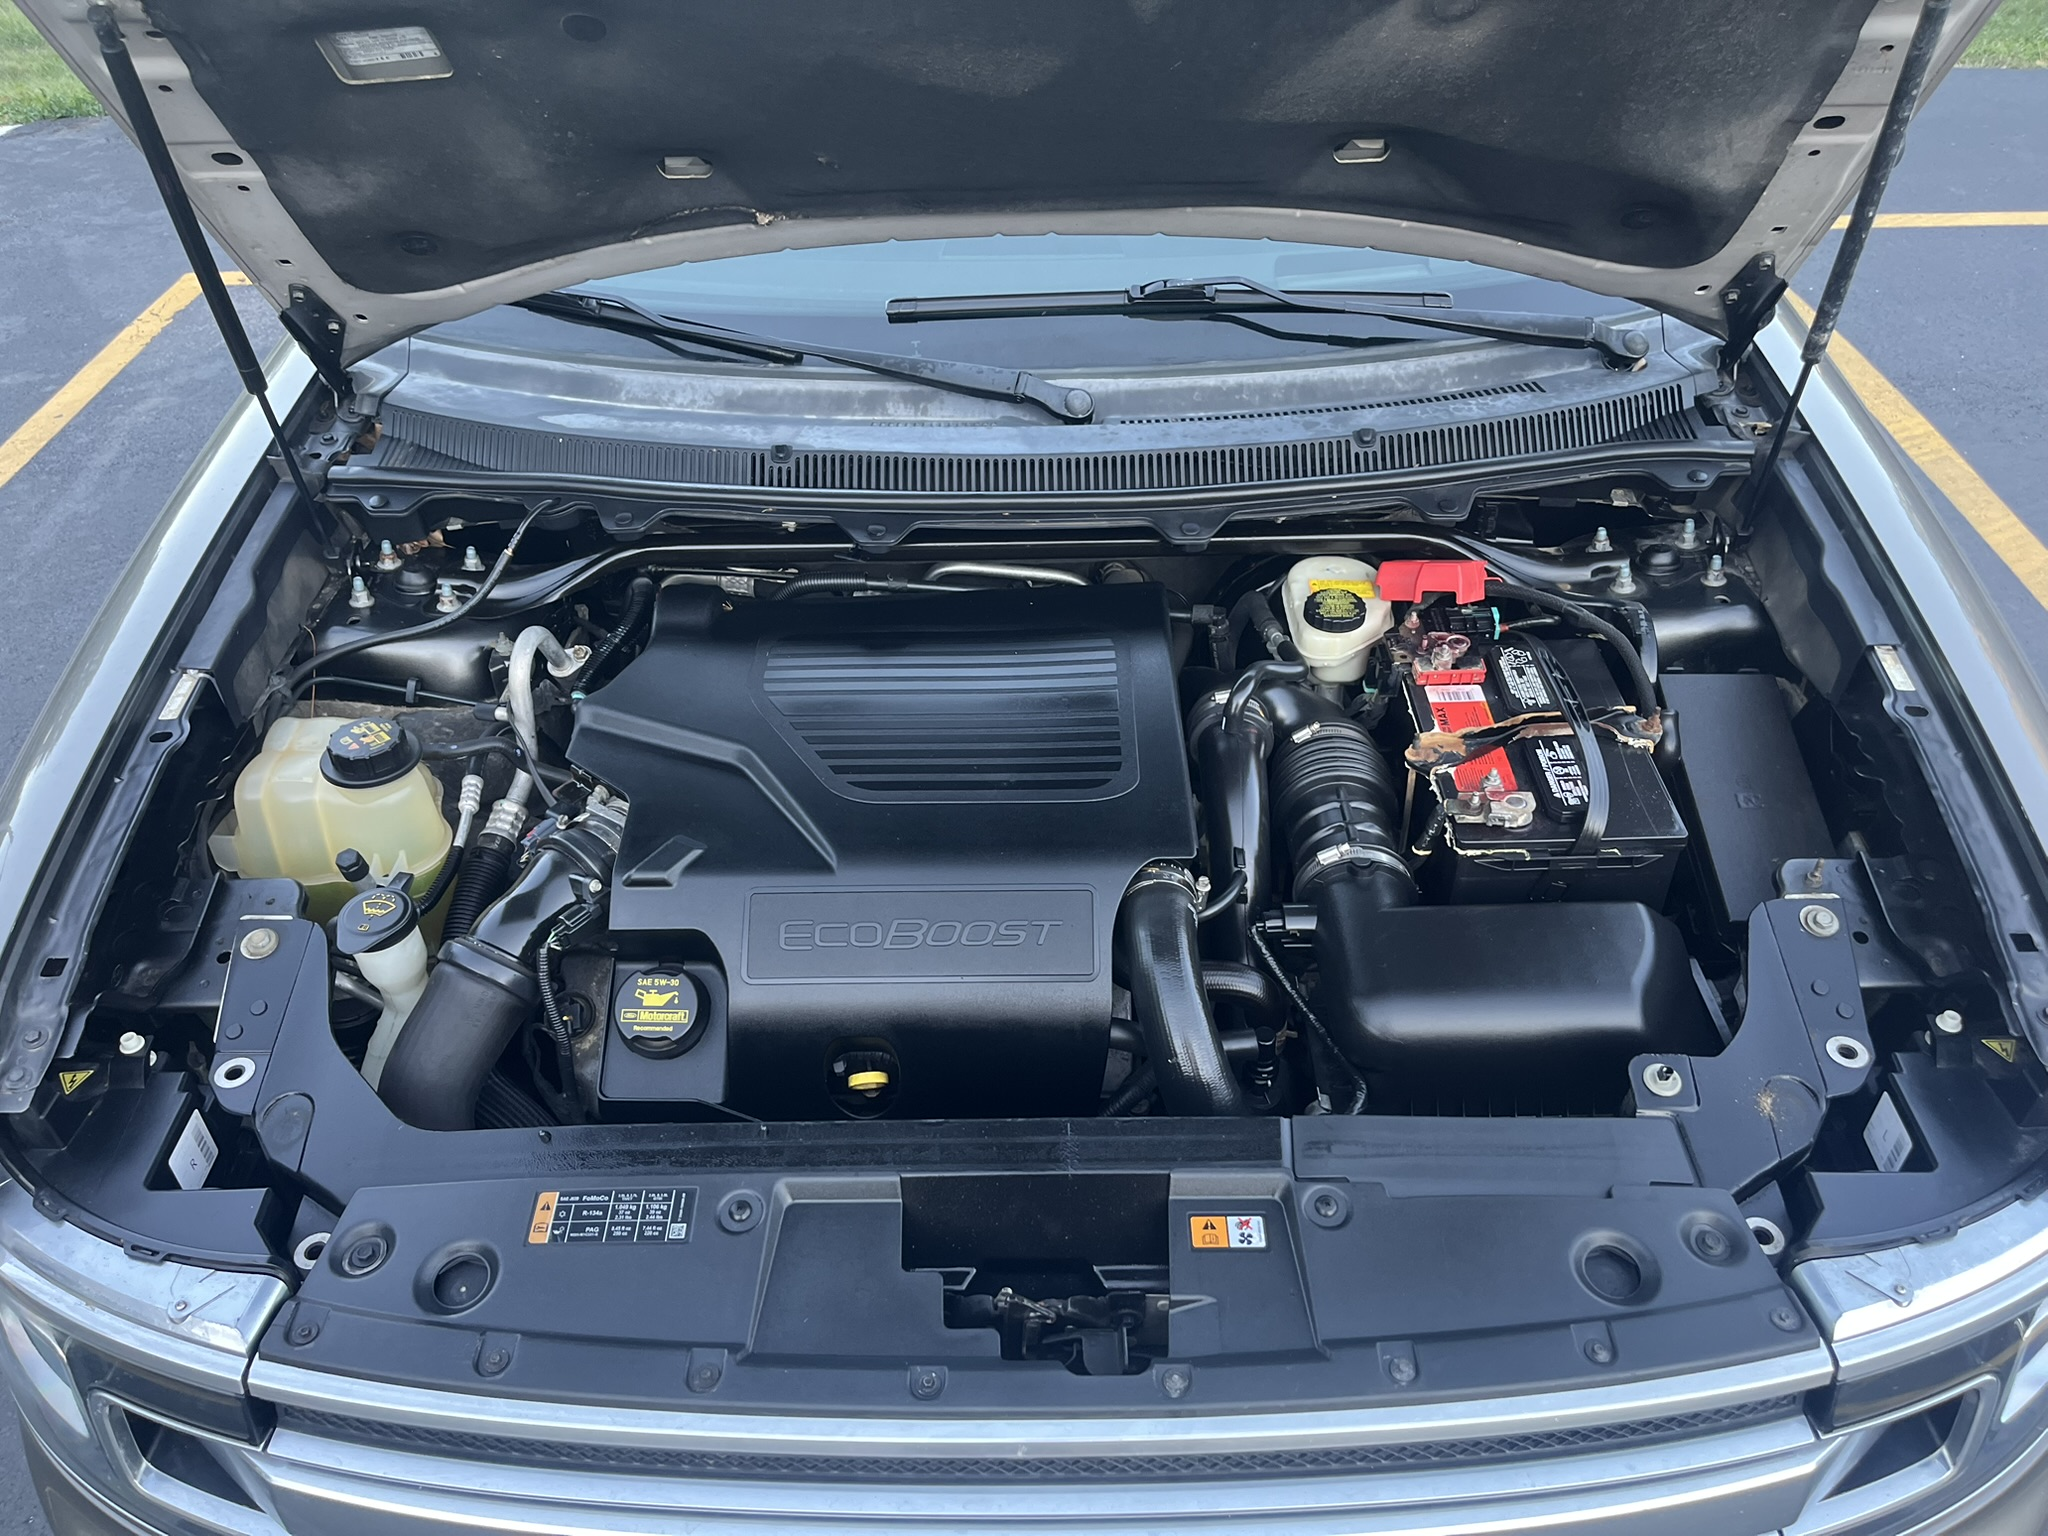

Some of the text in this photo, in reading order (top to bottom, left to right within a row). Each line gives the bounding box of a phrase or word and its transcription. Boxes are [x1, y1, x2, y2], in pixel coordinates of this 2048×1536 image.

[637, 978, 680, 987] SAE 5W-30
[640, 1010, 686, 1021] Motorcraft
